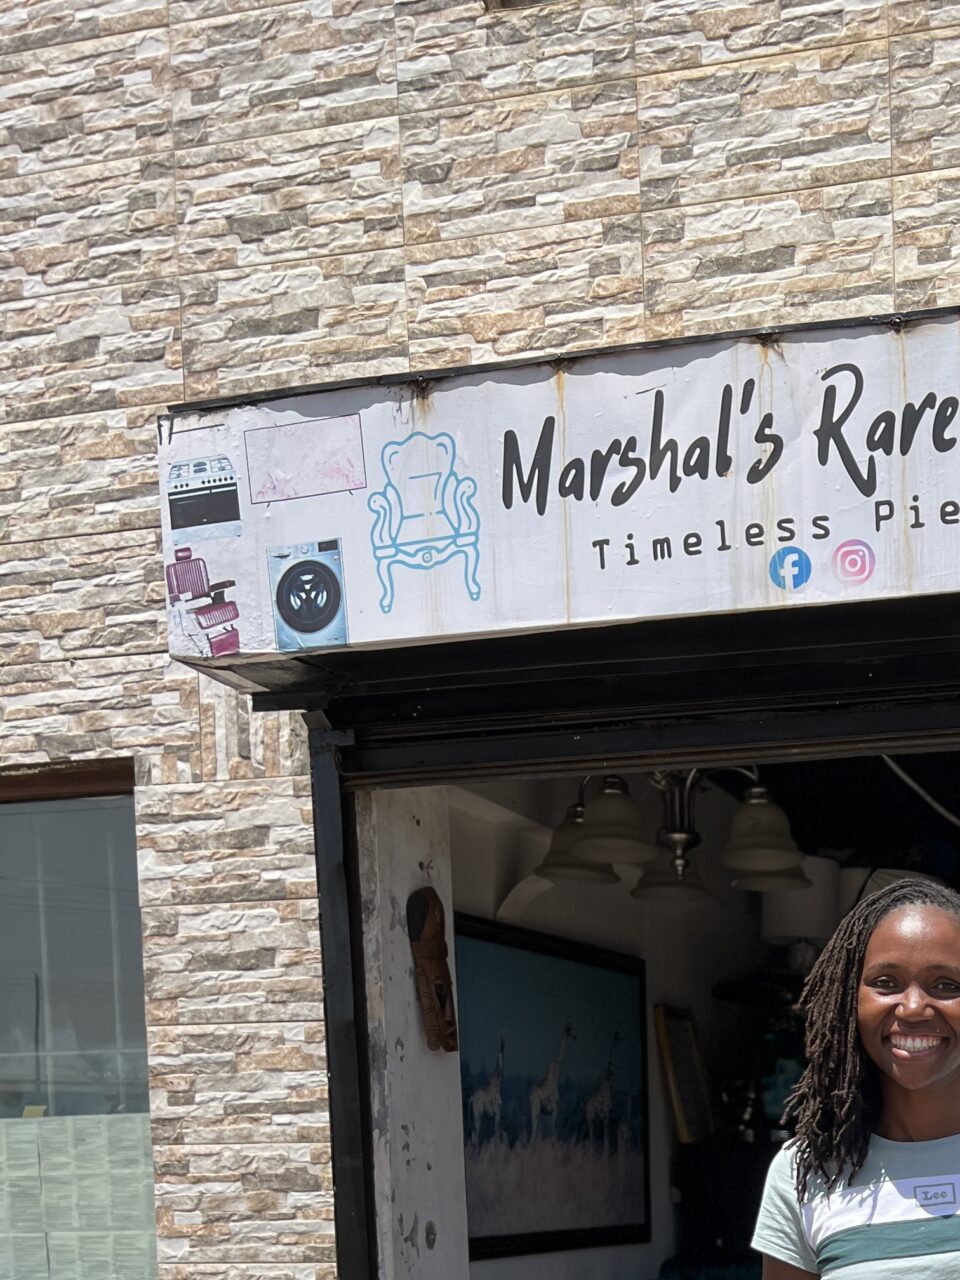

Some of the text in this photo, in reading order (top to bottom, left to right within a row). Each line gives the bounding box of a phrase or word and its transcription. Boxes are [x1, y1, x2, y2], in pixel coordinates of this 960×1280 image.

[502, 378, 784, 516] Marshal's
[814, 363, 959, 498] Rare
[591, 515, 831, 570] Timeless
[922, 1190, 948, 1201] Lee
